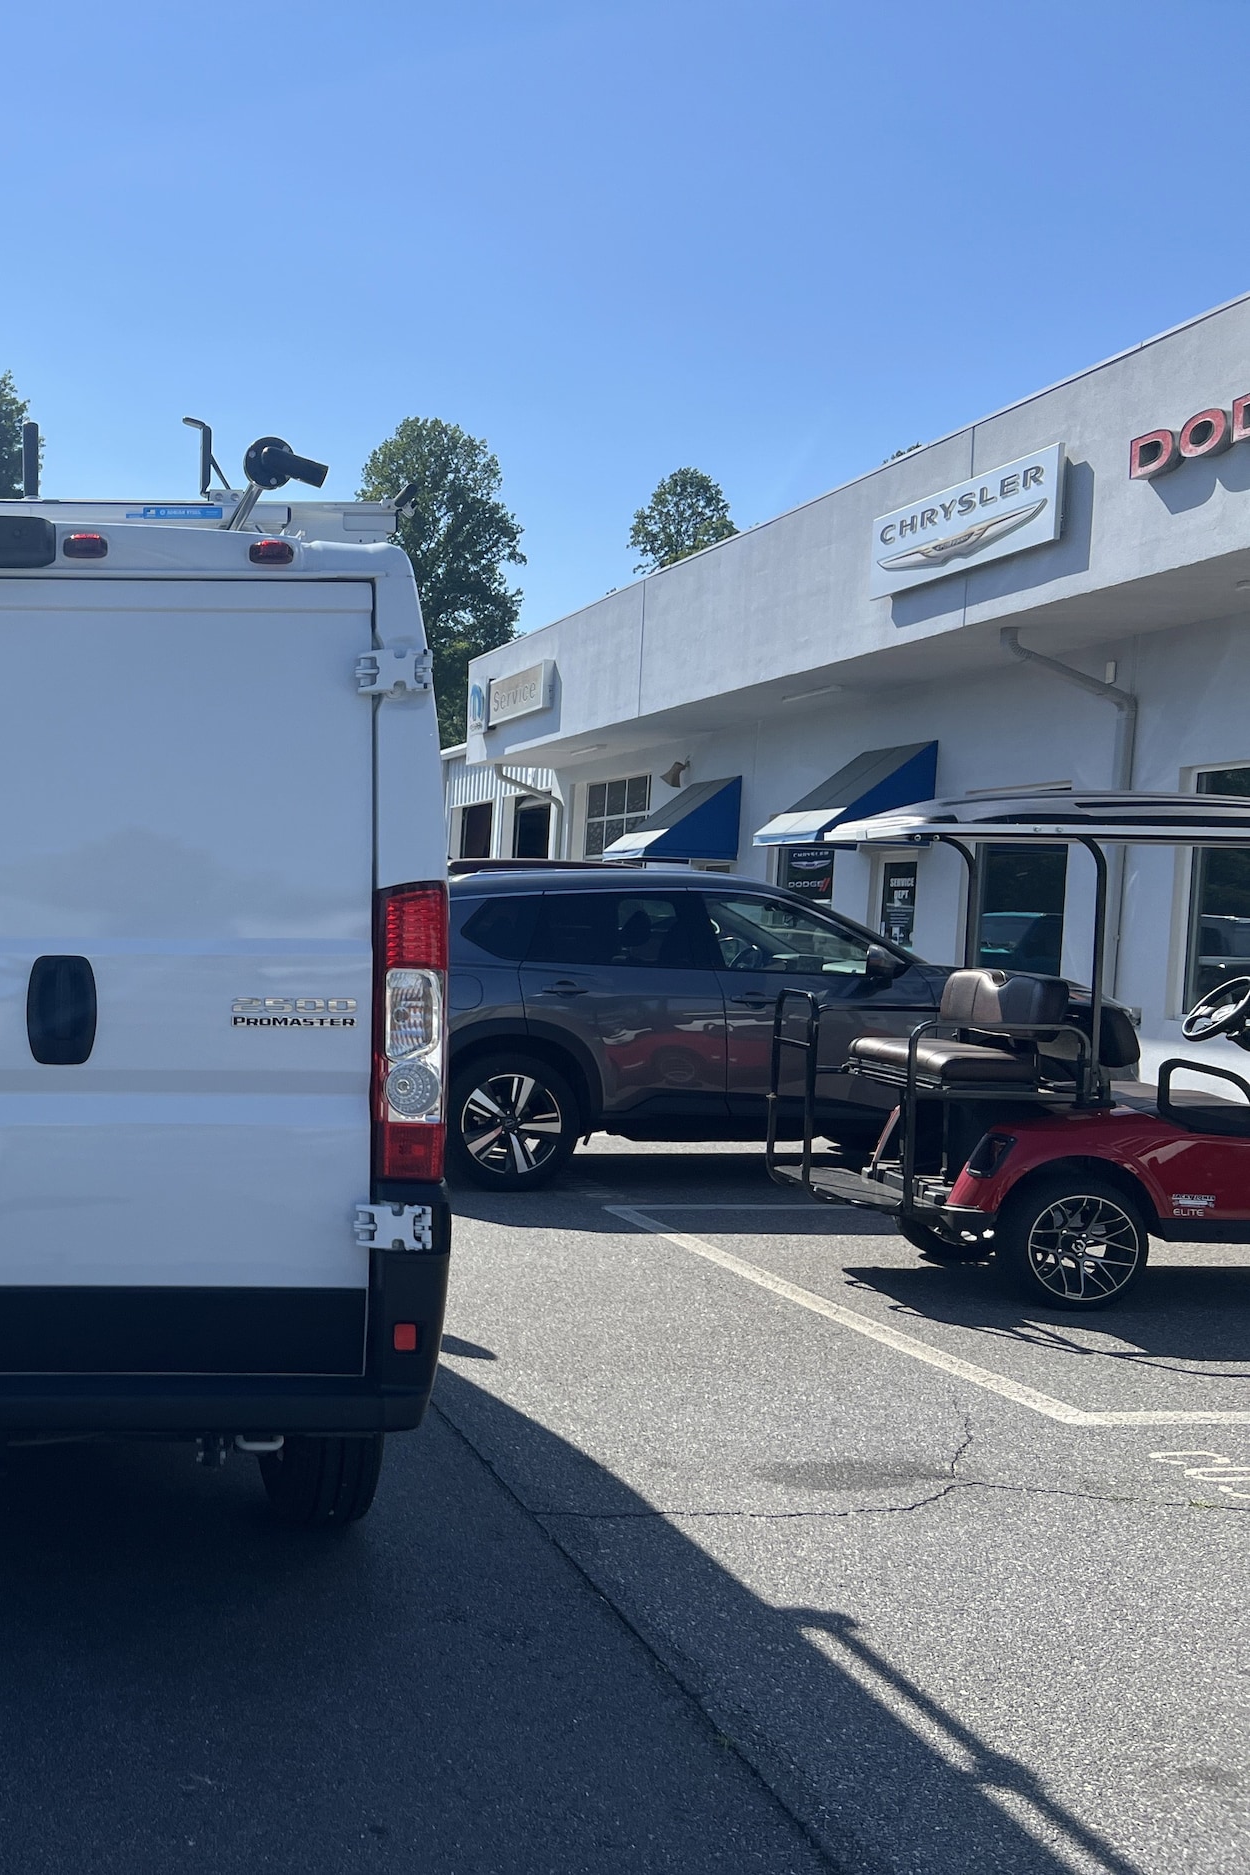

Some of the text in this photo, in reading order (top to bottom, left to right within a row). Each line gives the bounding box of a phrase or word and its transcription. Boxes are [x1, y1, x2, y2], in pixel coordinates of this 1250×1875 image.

[880, 465, 1044, 545] CHRYSLER
[493, 682, 536, 712] Service
[788, 880, 824, 888] DODGE
[890, 877, 915, 887] SERVICE
[894, 890, 910, 899] DEPT
[231, 998, 357, 1014] 2500
[1173, 1208, 1204, 1217] ELITE
